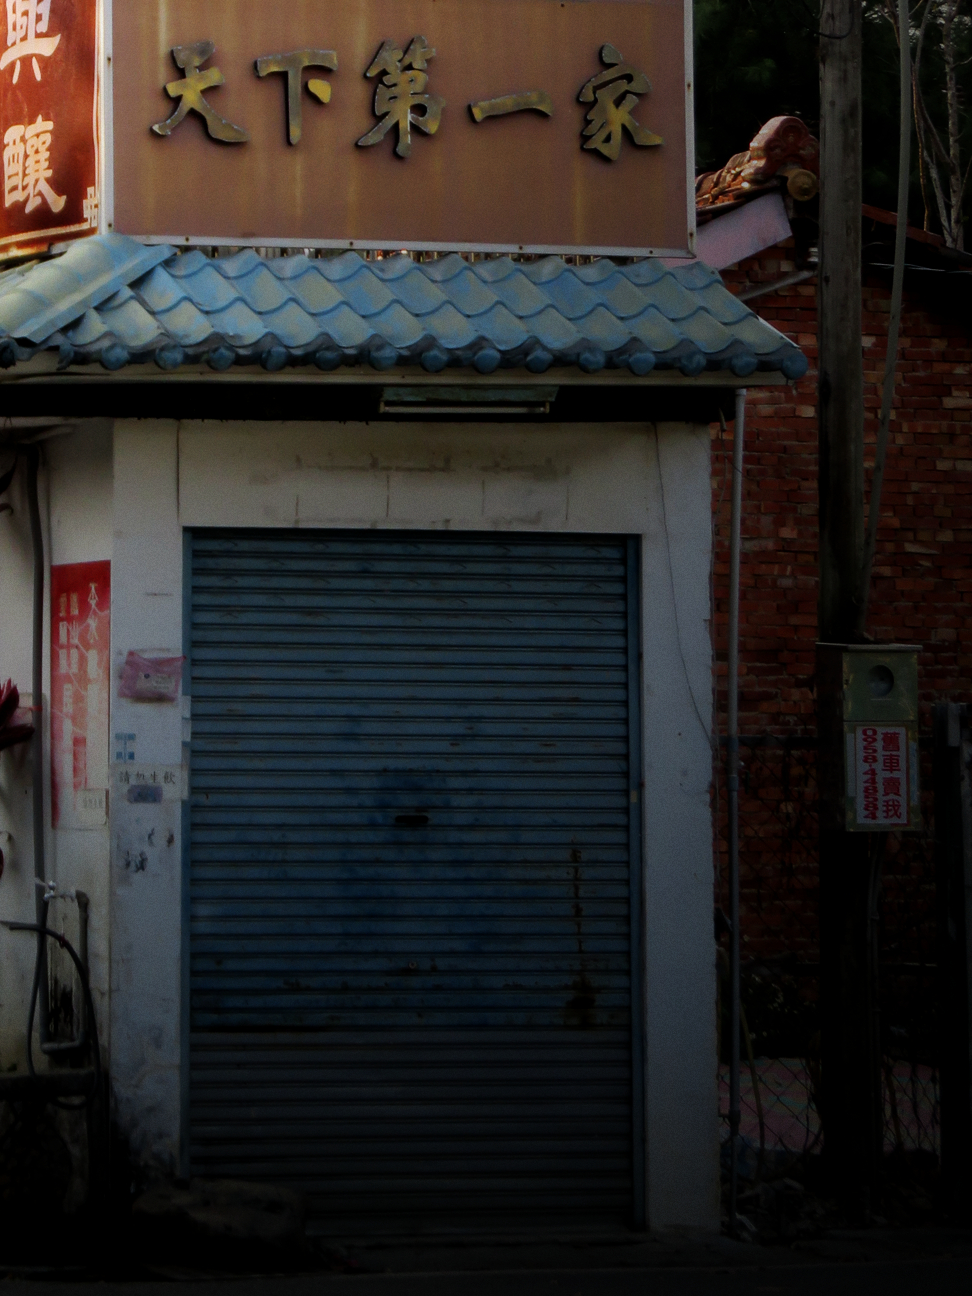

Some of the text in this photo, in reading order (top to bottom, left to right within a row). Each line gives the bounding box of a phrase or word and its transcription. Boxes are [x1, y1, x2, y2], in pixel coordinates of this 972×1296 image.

[150, 35, 665, 160] 天下第一家
[881, 732, 902, 819] 舊車賣我
